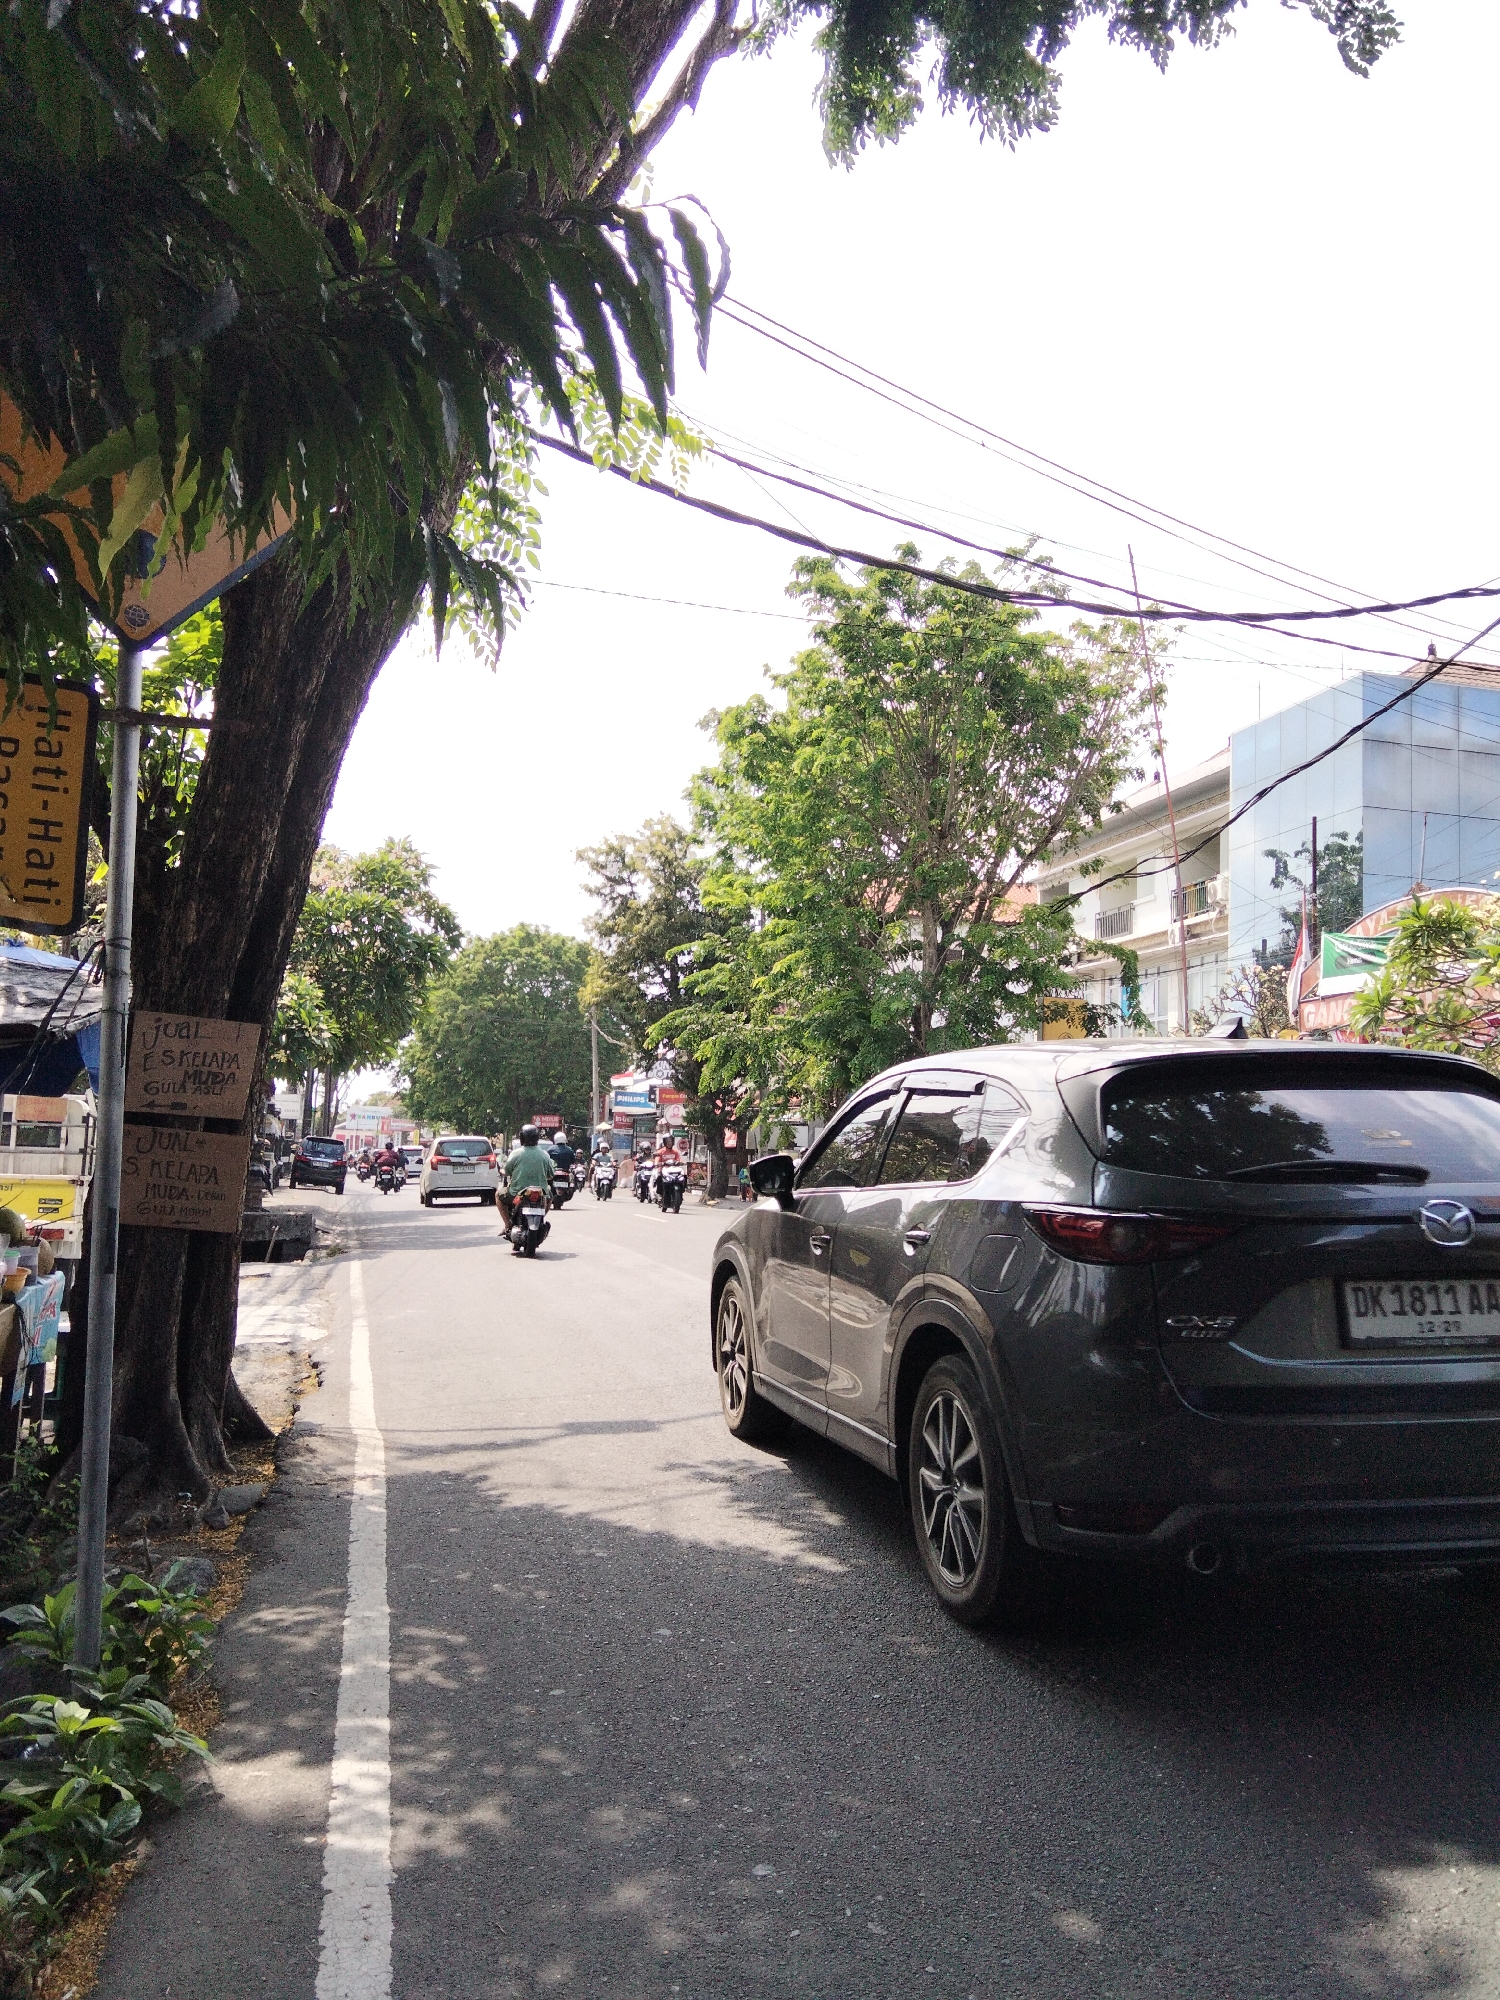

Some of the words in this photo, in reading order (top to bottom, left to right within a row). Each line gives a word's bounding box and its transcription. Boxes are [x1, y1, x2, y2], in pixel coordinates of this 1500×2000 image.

[23, 705, 72, 907] Hati-Hati
[178, 1049, 242, 1071] KELAPA
[183, 1069, 237, 1086] MUDA
[143, 1079, 187, 1096] GULA
[617, 1095, 645, 1104] PHILIPS
[150, 1158, 219, 1185] KELAPA
[136, 1201, 177, 1216] GULA
[1351, 1285, 1388, 1318] DK
[1390, 1284, 1462, 1317] 1811
